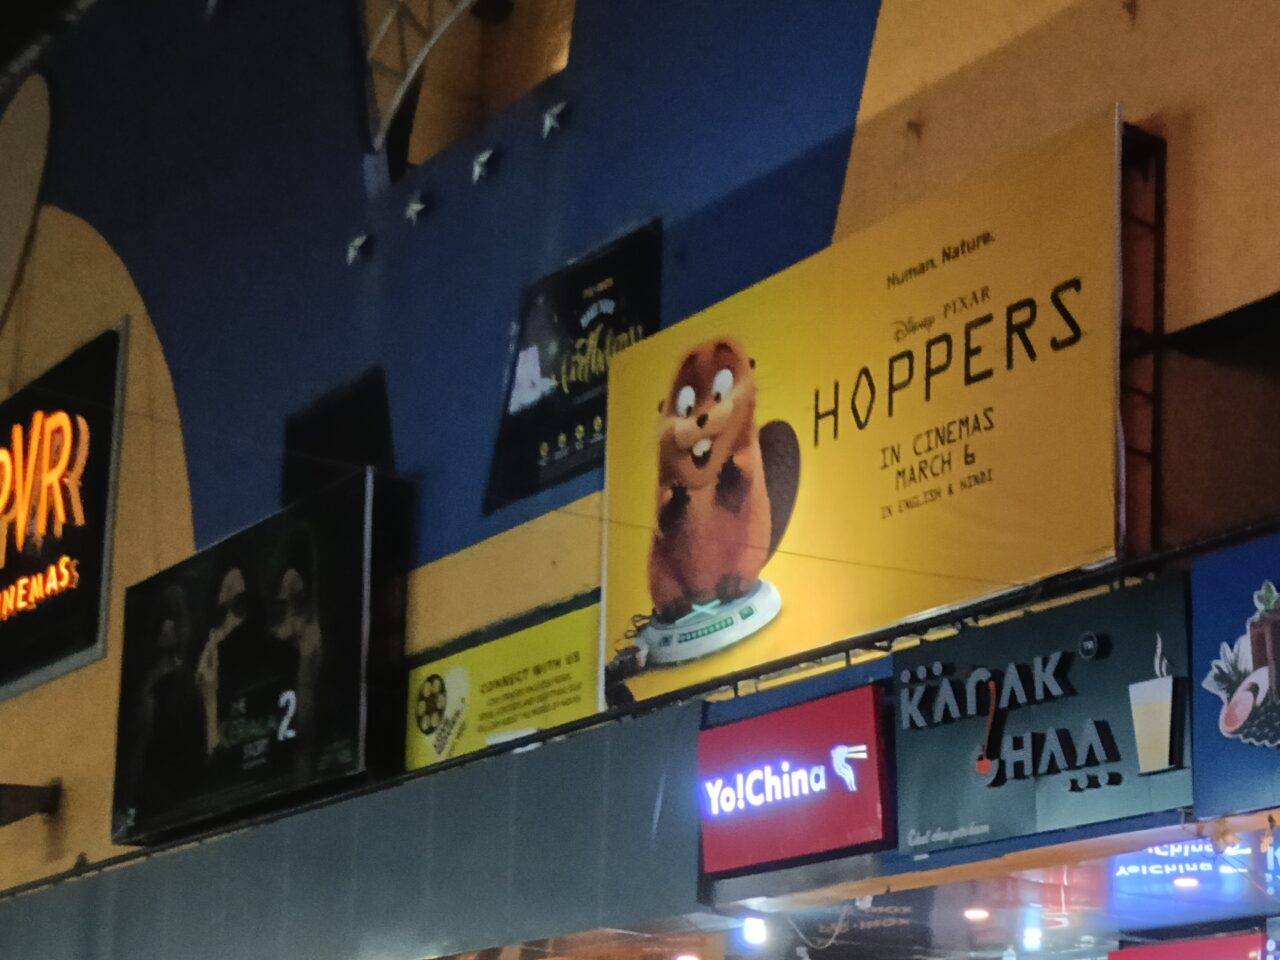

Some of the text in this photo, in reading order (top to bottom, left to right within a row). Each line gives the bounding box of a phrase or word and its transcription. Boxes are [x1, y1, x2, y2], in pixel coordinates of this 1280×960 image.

[944, 285, 991, 319] PIXAR
[812, 277, 1083, 447] HOPPERS
[880, 407, 994, 470] IN CINEMAS
[895, 443, 976, 491] MARCH 6
[0, 554, 72, 620] NEMAS
[276, 689, 298, 742] 2
[704, 759, 828, 818] Yo!China
